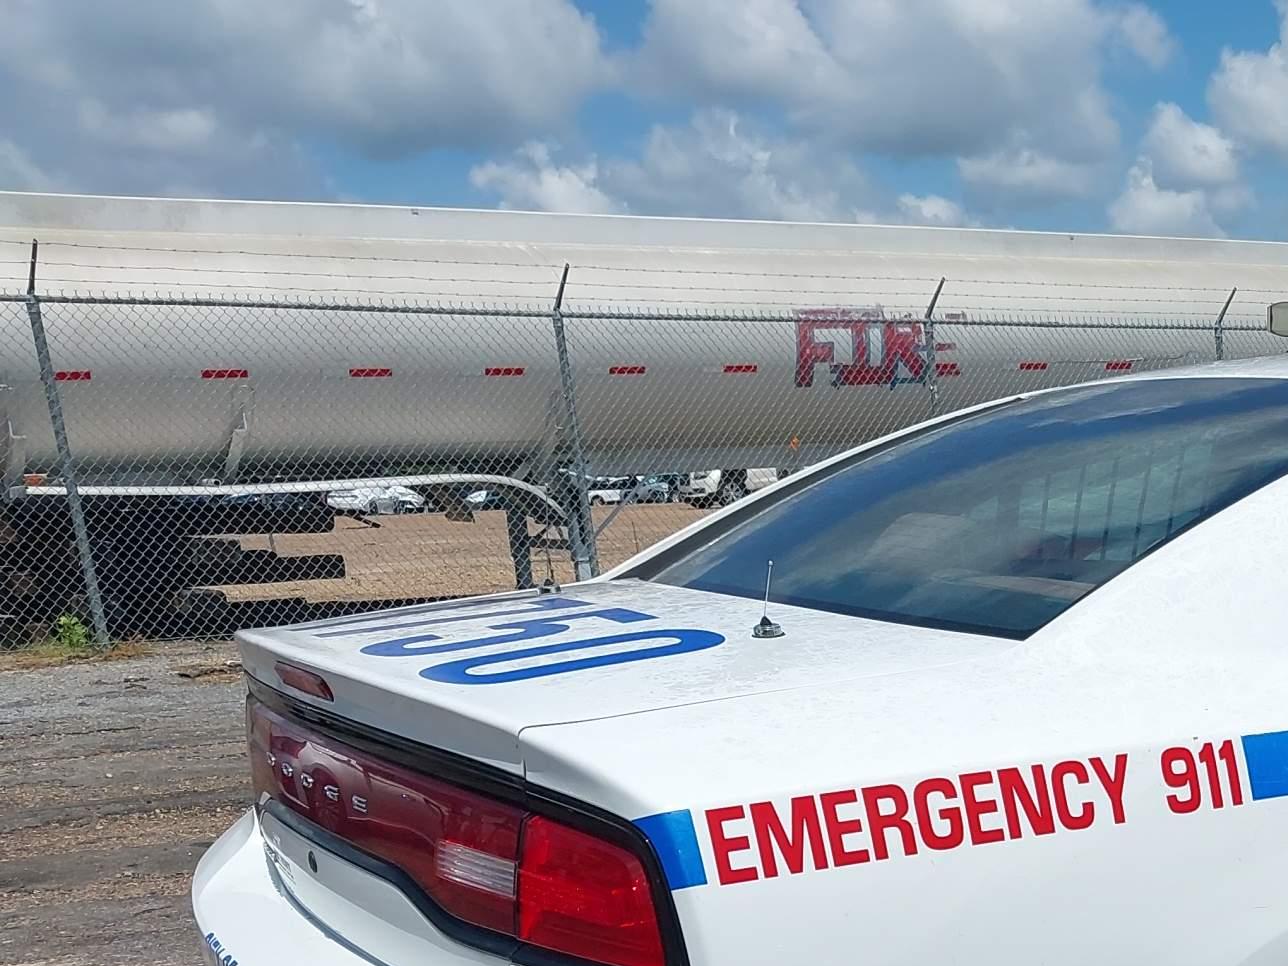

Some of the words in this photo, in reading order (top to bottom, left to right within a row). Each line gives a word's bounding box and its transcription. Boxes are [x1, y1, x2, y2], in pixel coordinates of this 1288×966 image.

[266, 751, 368, 814] DODGE
[705, 753, 1128, 886] EMERGENCY
[1160, 739, 1243, 814] 911
